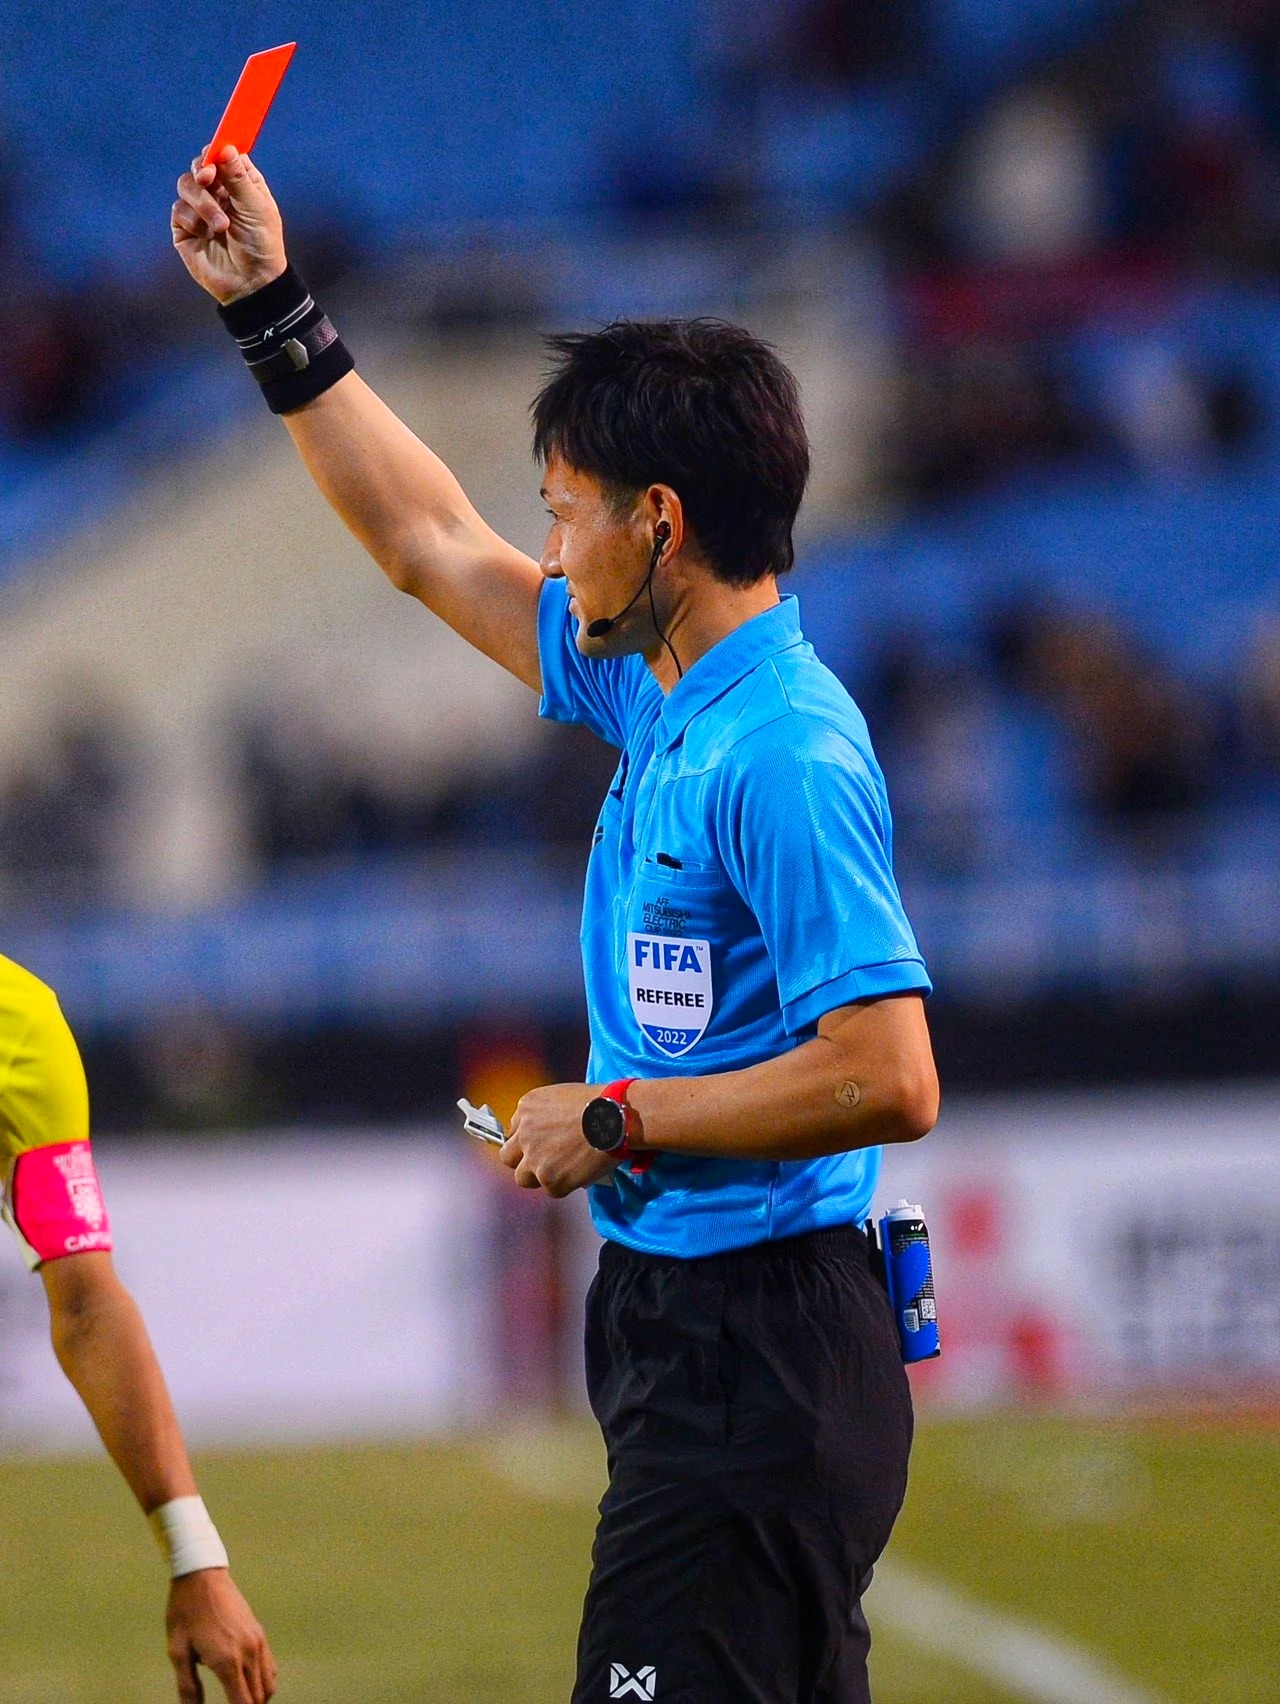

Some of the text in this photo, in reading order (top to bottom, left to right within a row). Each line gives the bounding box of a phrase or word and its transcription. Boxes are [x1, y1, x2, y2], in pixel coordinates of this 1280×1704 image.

[656, 897, 671, 906] AFF
[642, 901, 691, 919] MITSUBISHI
[643, 913, 687, 929] ELECTRIC
[645, 924, 661, 933] CUP
[634, 940, 702, 973] FIFA
[636, 988, 705, 1008] REFEREE
[657, 1029, 687, 1045] 2022
